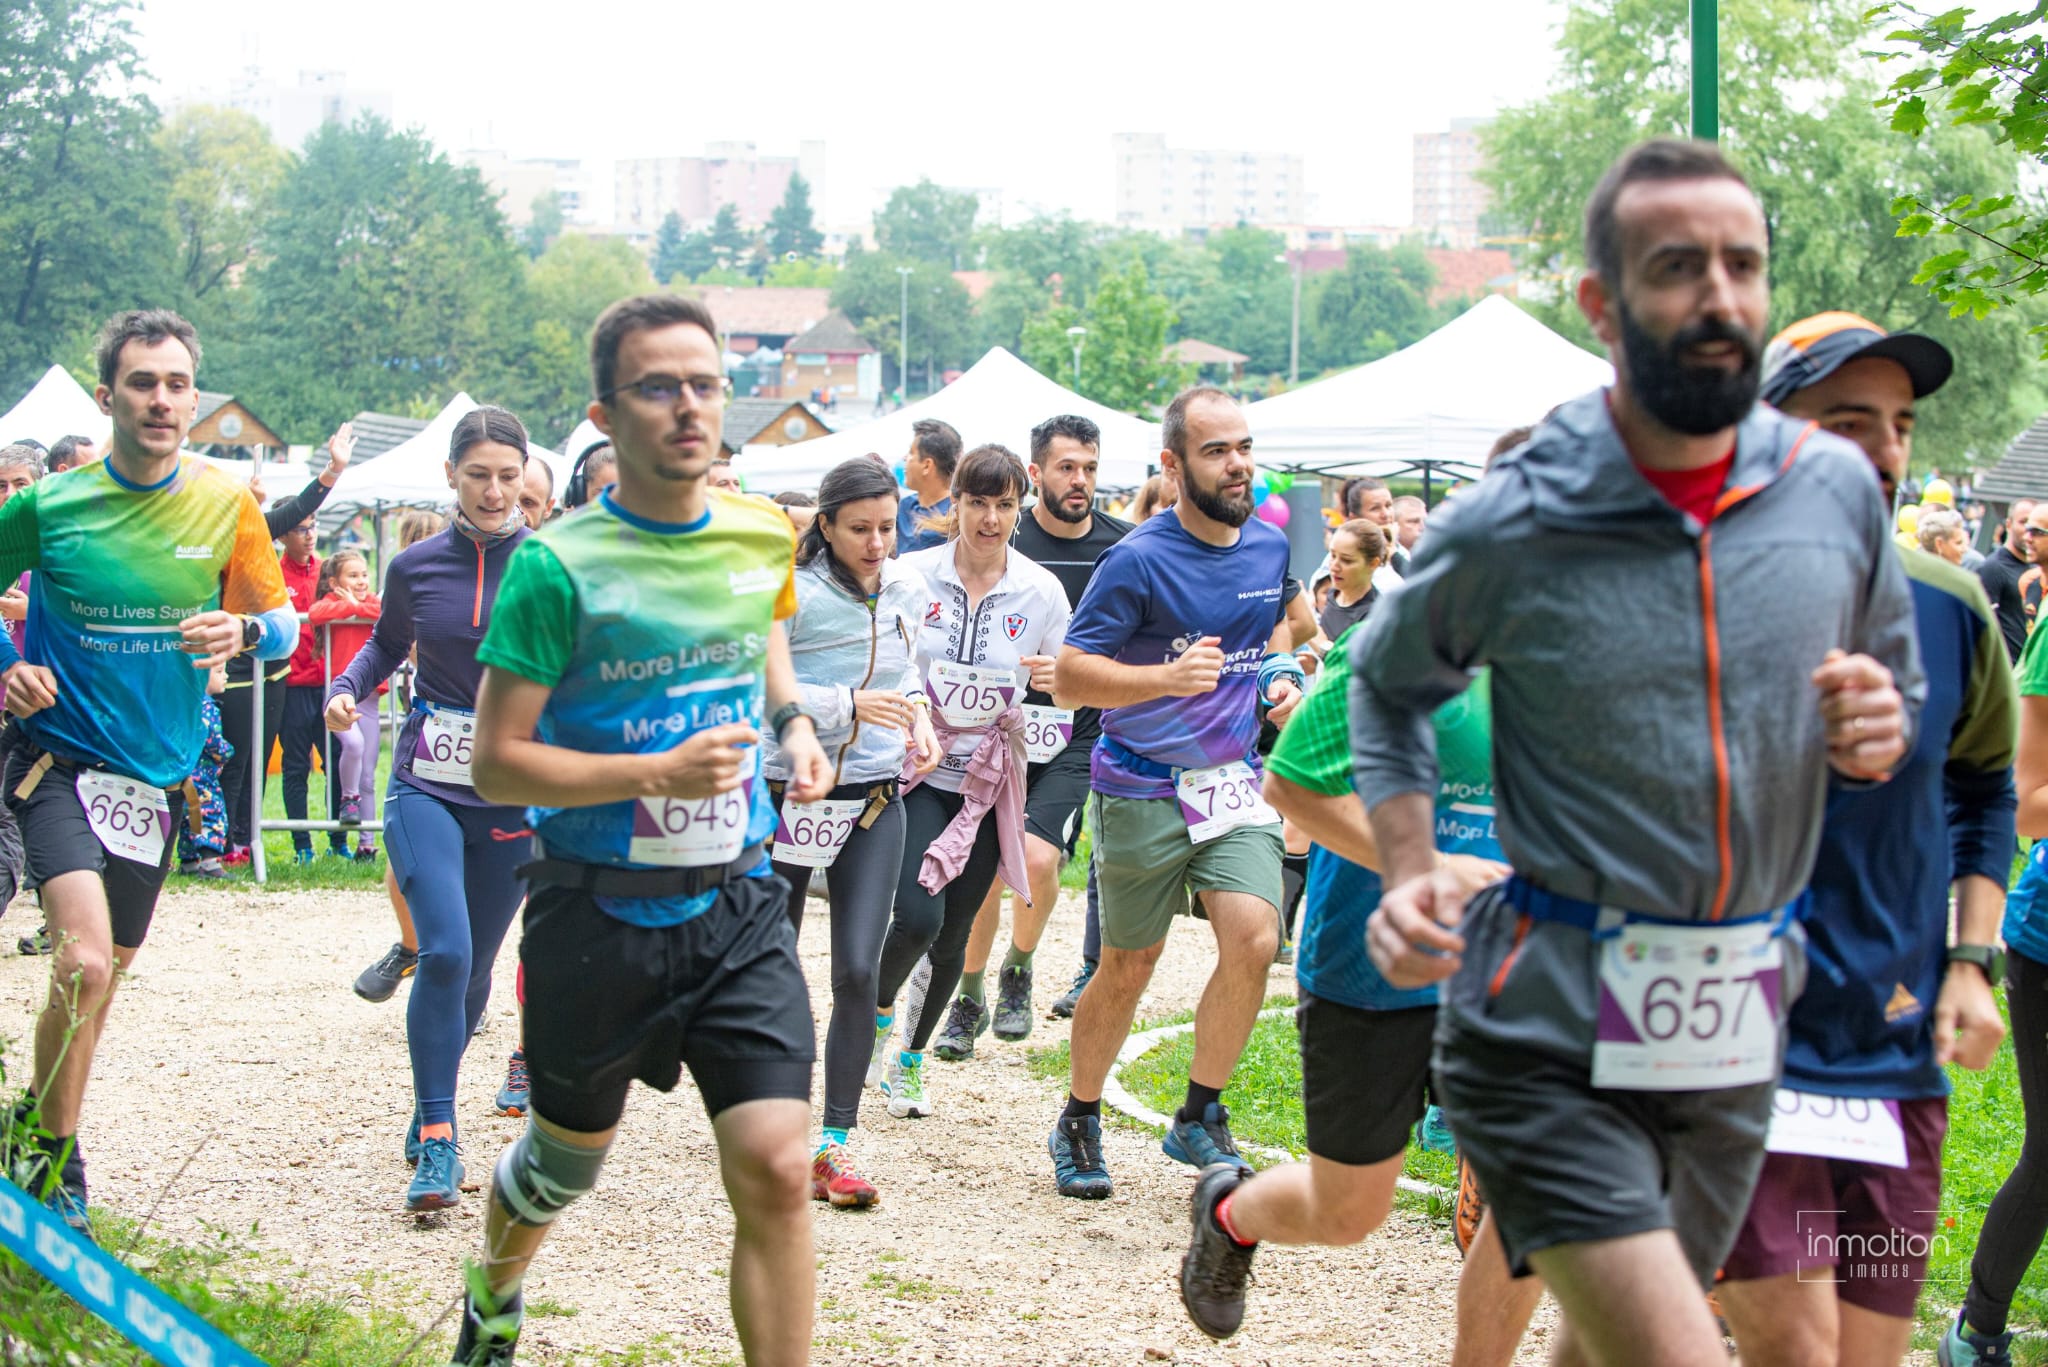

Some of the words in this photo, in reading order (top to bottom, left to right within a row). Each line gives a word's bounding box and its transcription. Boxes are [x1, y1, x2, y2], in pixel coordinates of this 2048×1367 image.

[70, 600, 110, 618] More
[112, 604, 156, 619] Lives
[79, 635, 119, 653] More
[122, 638, 150, 654] Life
[600, 655, 675, 683] More
[678, 640, 741, 669] Lives
[943, 680, 1000, 711] 705
[433, 733, 474, 765] 65
[1024, 721, 1058, 747] 36
[662, 791, 742, 835] 645
[1198, 779, 1255, 817] 733
[90, 794, 154, 837] 663
[793, 817, 852, 848] 662
[1641, 974, 1758, 1041] 657
